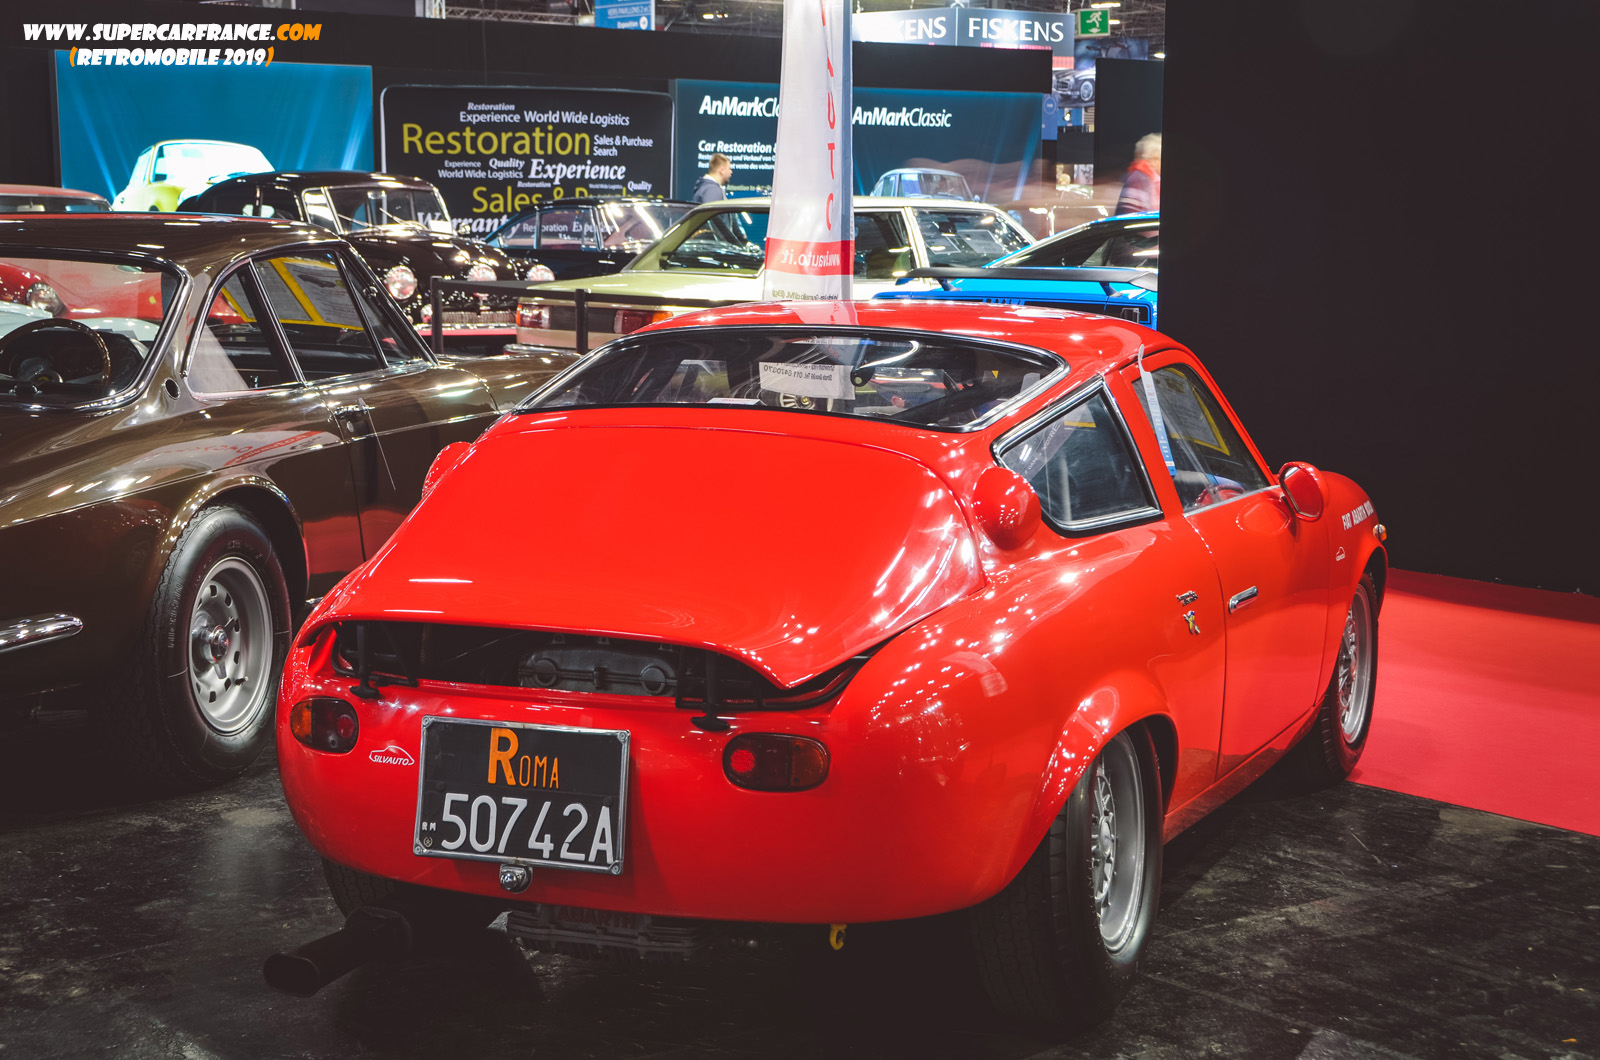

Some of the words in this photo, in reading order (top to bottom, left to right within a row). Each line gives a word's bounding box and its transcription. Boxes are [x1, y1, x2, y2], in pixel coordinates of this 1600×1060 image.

[968, 17, 1064, 42] FISKENS
[467, 102, 515, 111] Restoration
[459, 111, 521, 125] Experience
[523, 110, 560, 123] World
[561, 110, 588, 124] Wide
[589, 112, 630, 128] Logistics
[852, 106, 952, 128] AnMarkClassic
[402, 123, 591, 156] Restoration
[593, 134, 614, 146] Sales
[614, 135, 621, 146] &
[621, 135, 653, 147] Purchase
[593, 146, 618, 157] Search
[698, 140, 716, 152] Car
[717, 140, 773, 154] Restoration
[444, 160, 482, 169] Experience
[489, 157, 525, 170] Quality
[438, 169, 464, 179] World
[465, 169, 487, 179] Wide
[487, 170, 524, 180] Logistics
[527, 158, 626, 186] Experience
[517, 180, 552, 188] Restoration
[627, 180, 653, 193] Quality
[472, 185, 543, 213] Sales
[374, 754, 410, 766] SILVAUTO
[441, 792, 614, 864] 50742A
